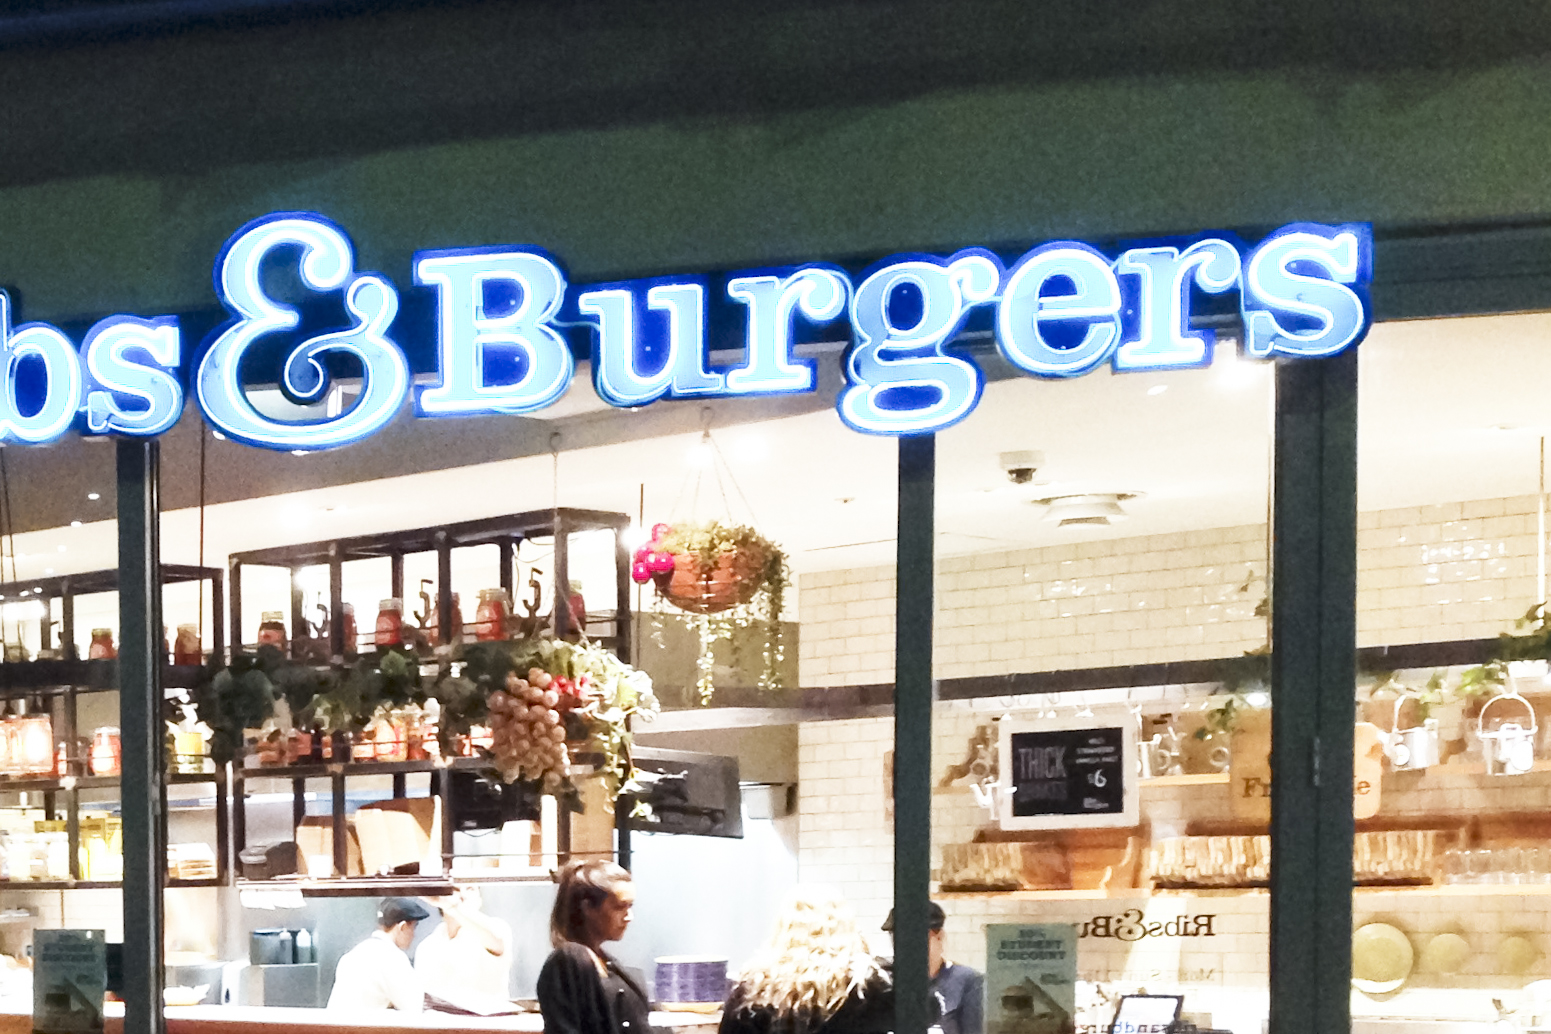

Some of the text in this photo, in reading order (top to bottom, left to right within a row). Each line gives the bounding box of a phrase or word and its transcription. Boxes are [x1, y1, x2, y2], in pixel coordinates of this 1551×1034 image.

[1017, 746, 1067, 779] THICK
[1000, 939, 1062, 950] STUDENT
[996, 951, 1067, 961] DISCOUNT
